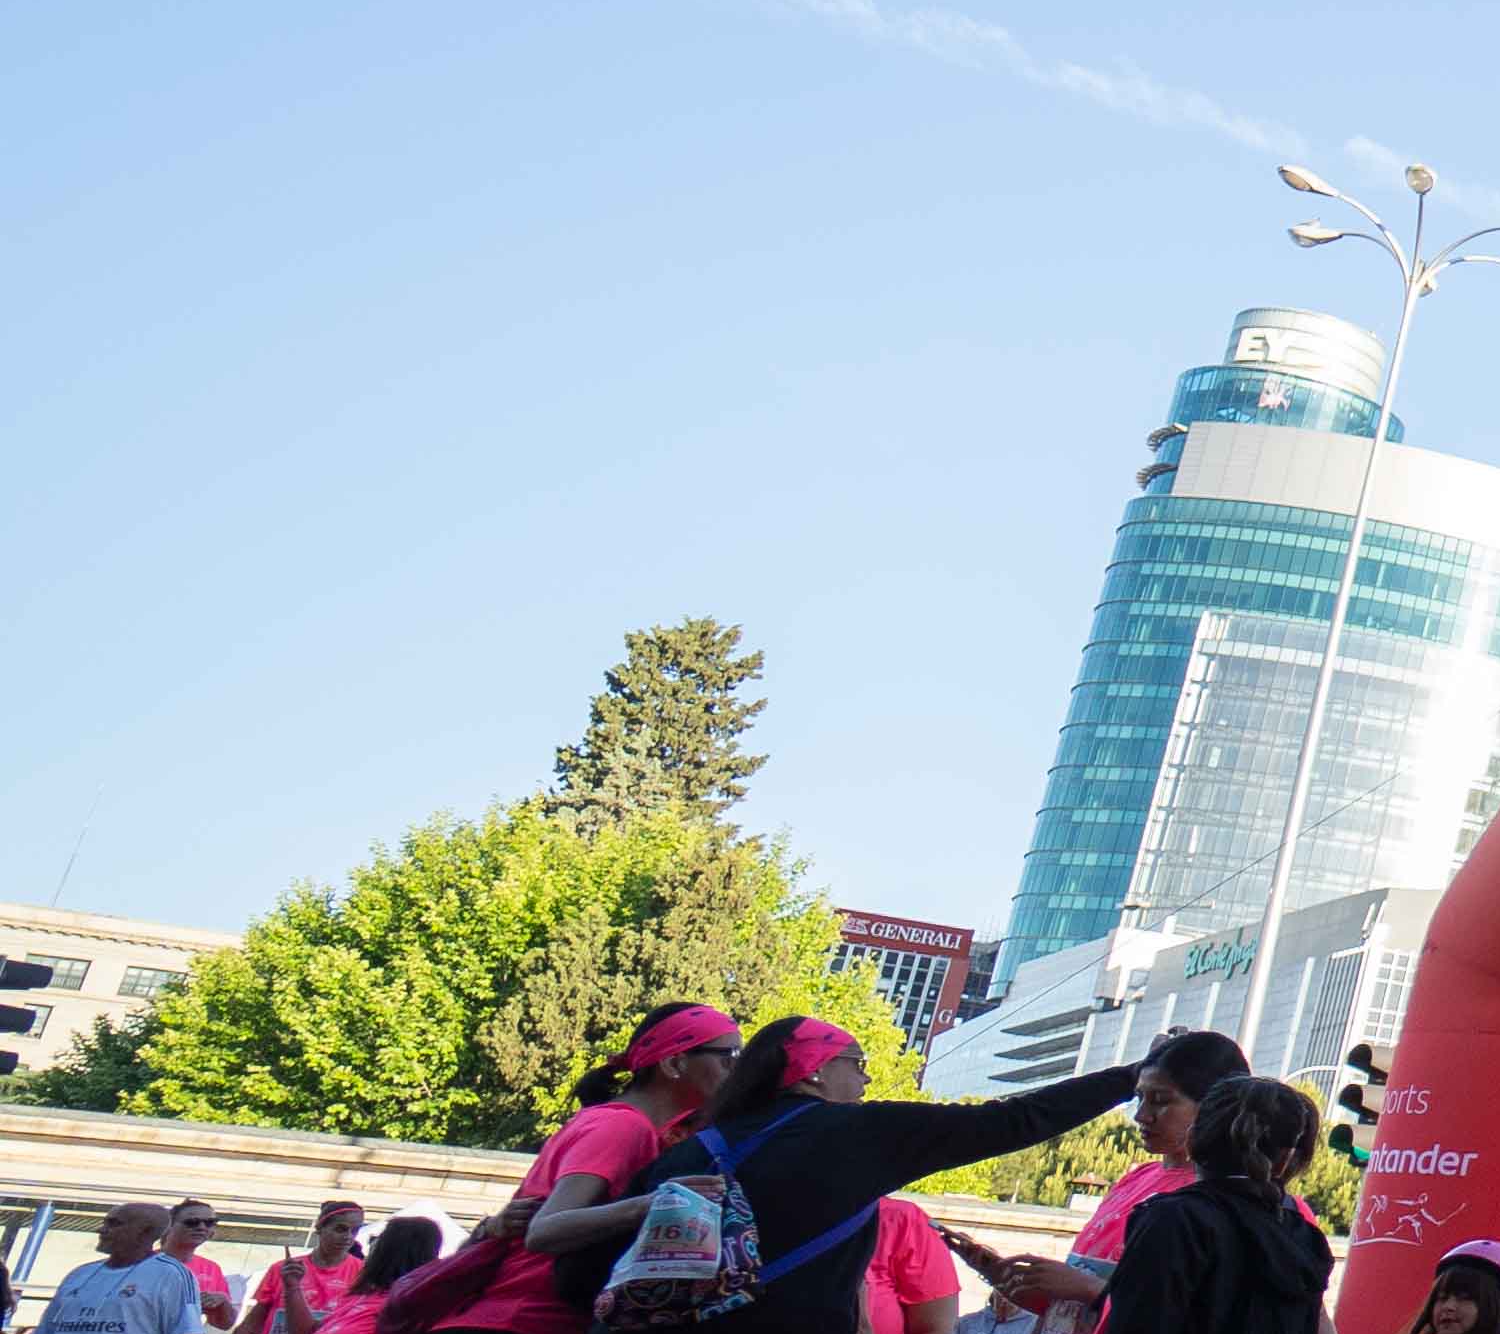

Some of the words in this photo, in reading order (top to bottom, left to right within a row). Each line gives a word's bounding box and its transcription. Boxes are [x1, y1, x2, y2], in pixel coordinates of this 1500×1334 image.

[1233, 327, 1289, 364] EY
[870, 921, 963, 950] GENERALI
[938, 1008, 953, 1025] G
[1382, 1083, 1431, 1115] orts
[1367, 1142, 1479, 1177] ntander
